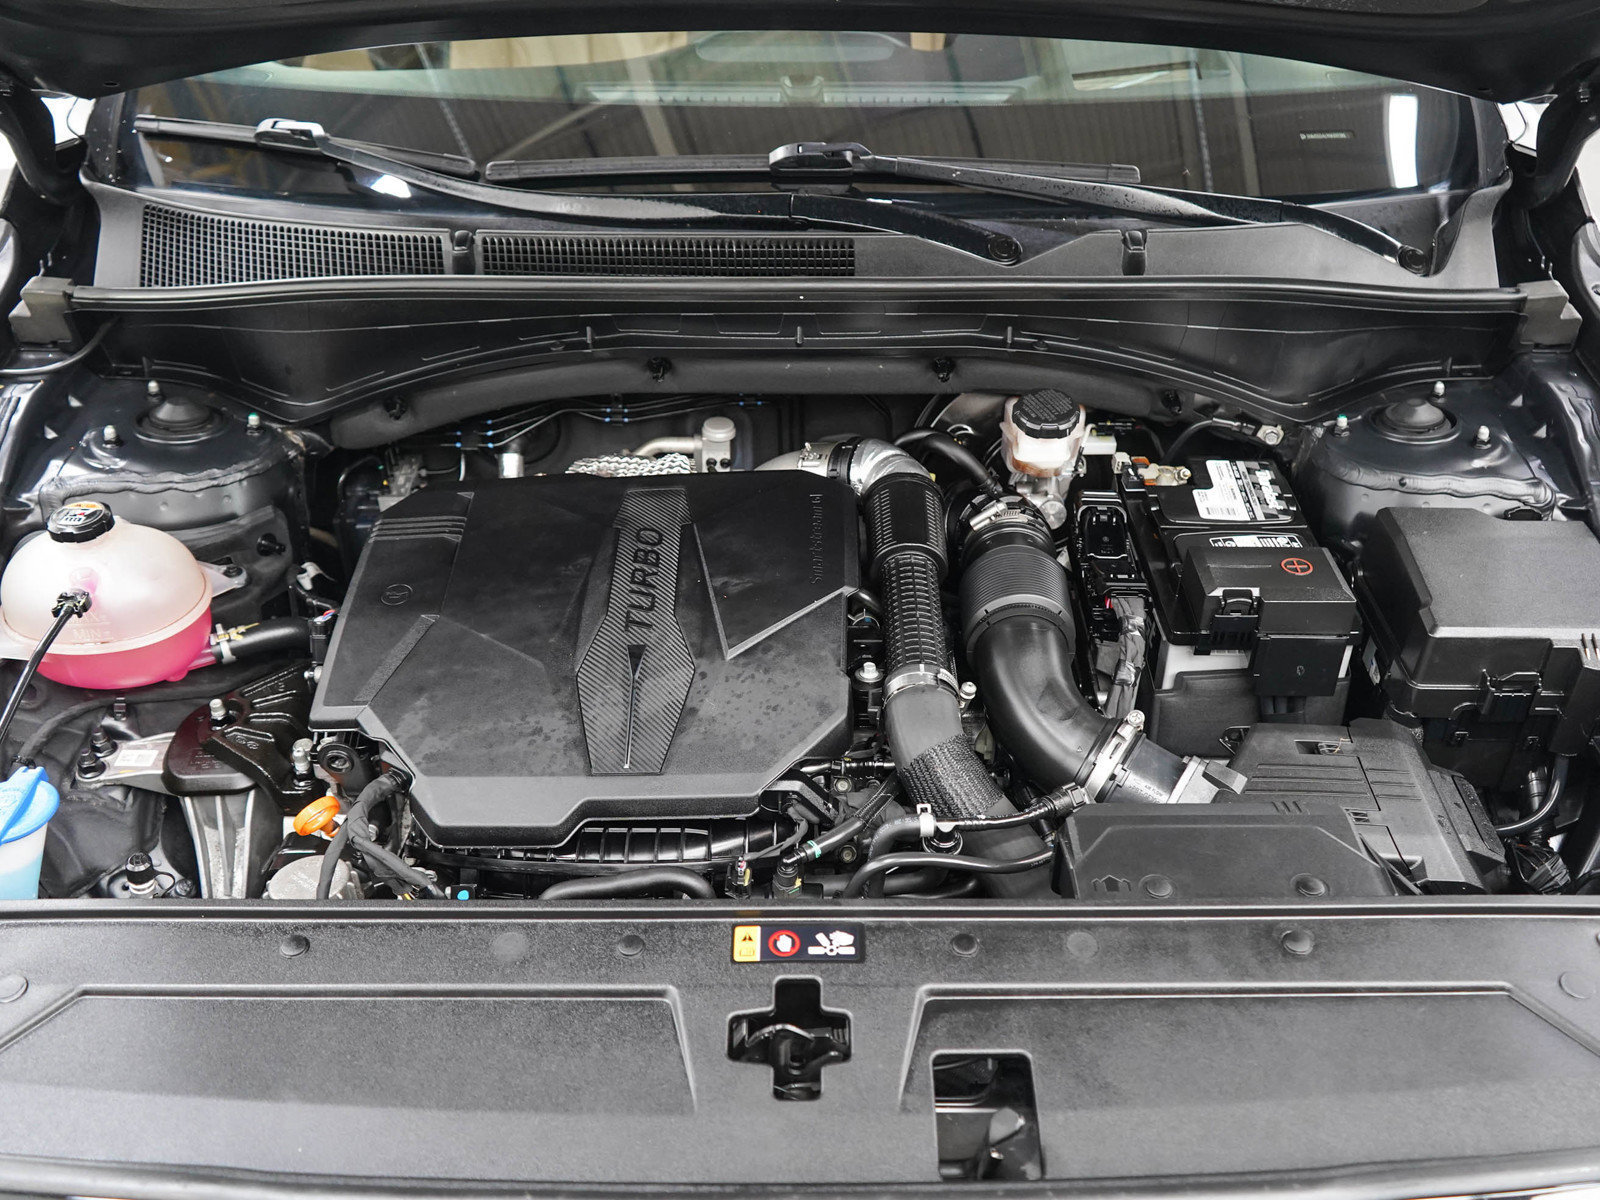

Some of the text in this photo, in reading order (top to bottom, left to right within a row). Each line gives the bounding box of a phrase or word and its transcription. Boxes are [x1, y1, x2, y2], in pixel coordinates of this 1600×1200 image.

[1254, 470, 1284, 510] Duralast
[624, 527, 662, 632] TURBO
[808, 506, 824, 584] Smartstream
